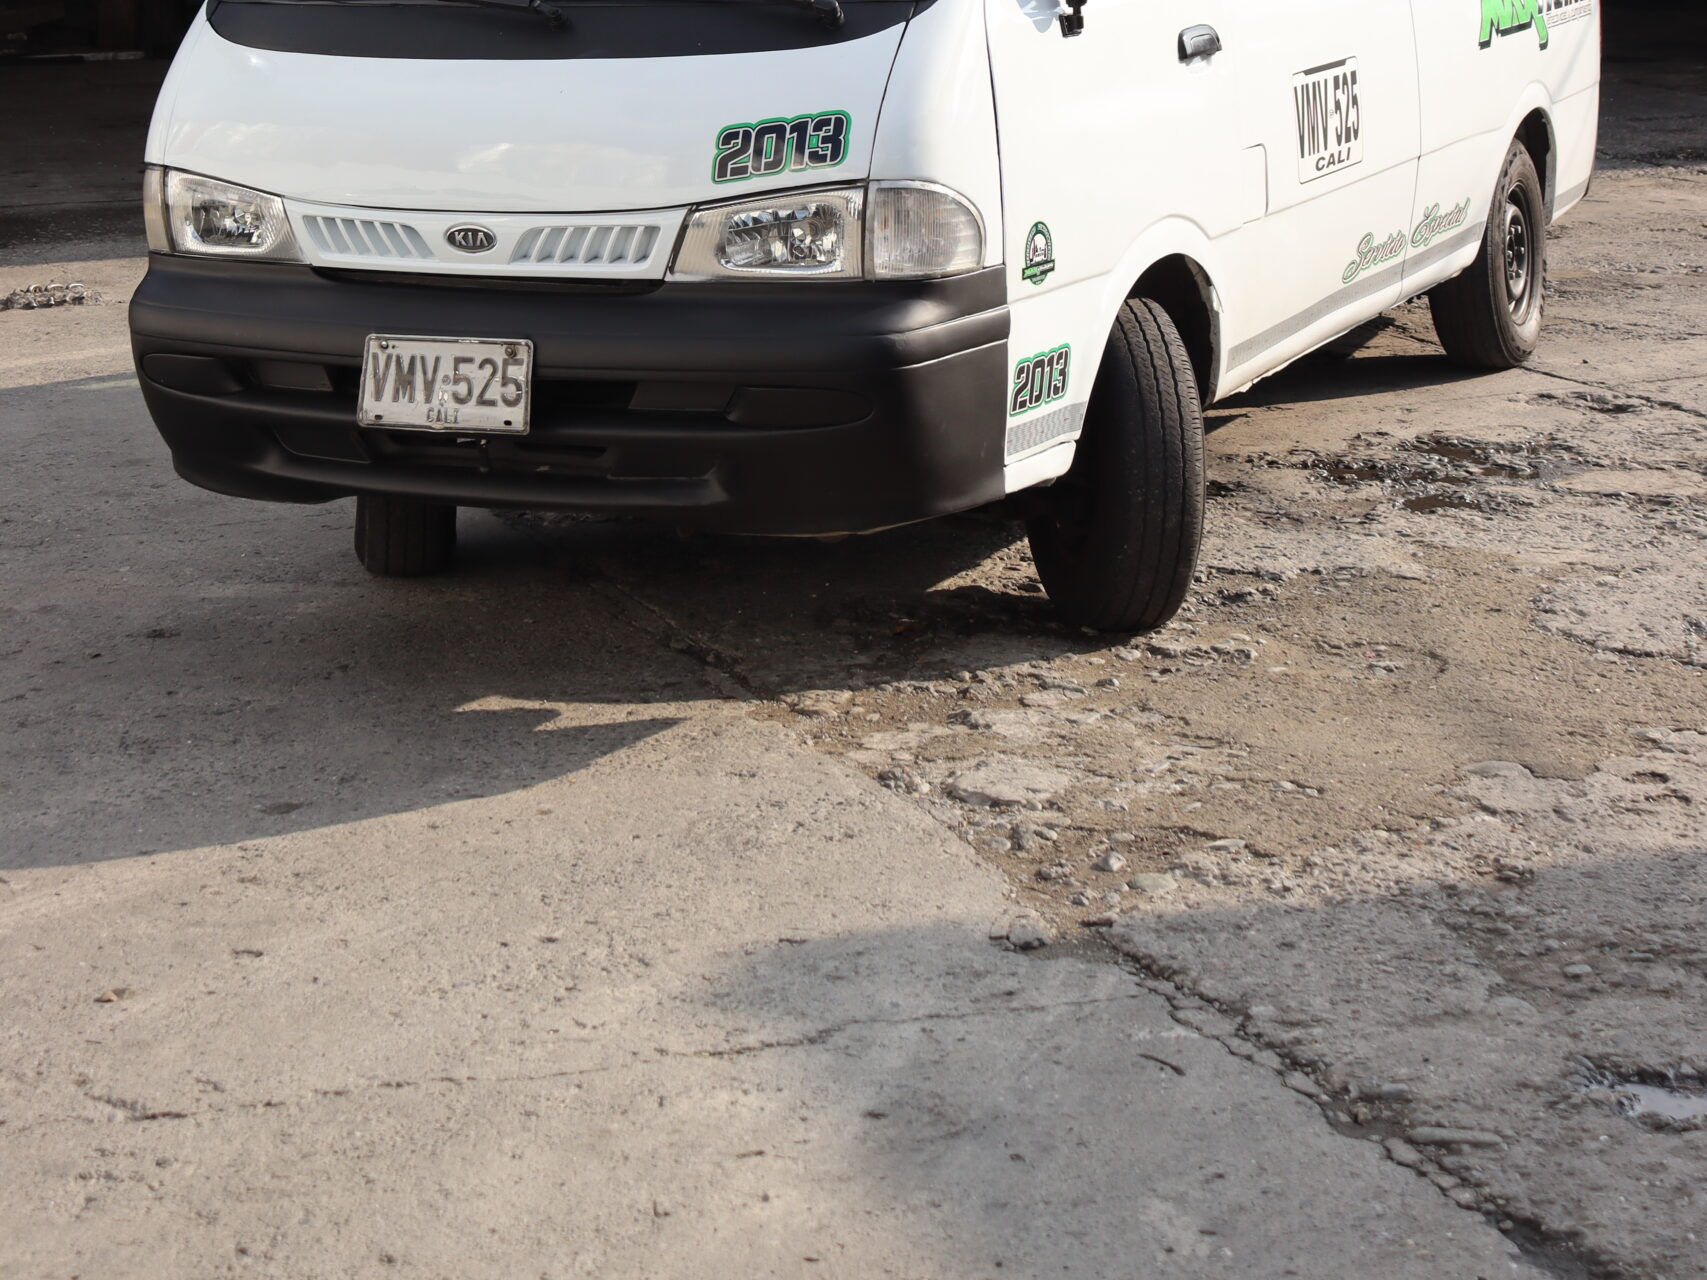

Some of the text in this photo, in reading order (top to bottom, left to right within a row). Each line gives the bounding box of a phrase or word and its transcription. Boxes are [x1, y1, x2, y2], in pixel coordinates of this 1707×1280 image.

[1294, 70, 1360, 159] VMV 525
[712, 111, 850, 183] 2013
[1315, 146, 1351, 172] CALI
[453, 231, 488, 247] KIA
[370, 352, 524, 407] VMV 525
[1010, 345, 1070, 416] 2013
[426, 407, 460, 425] CALI
